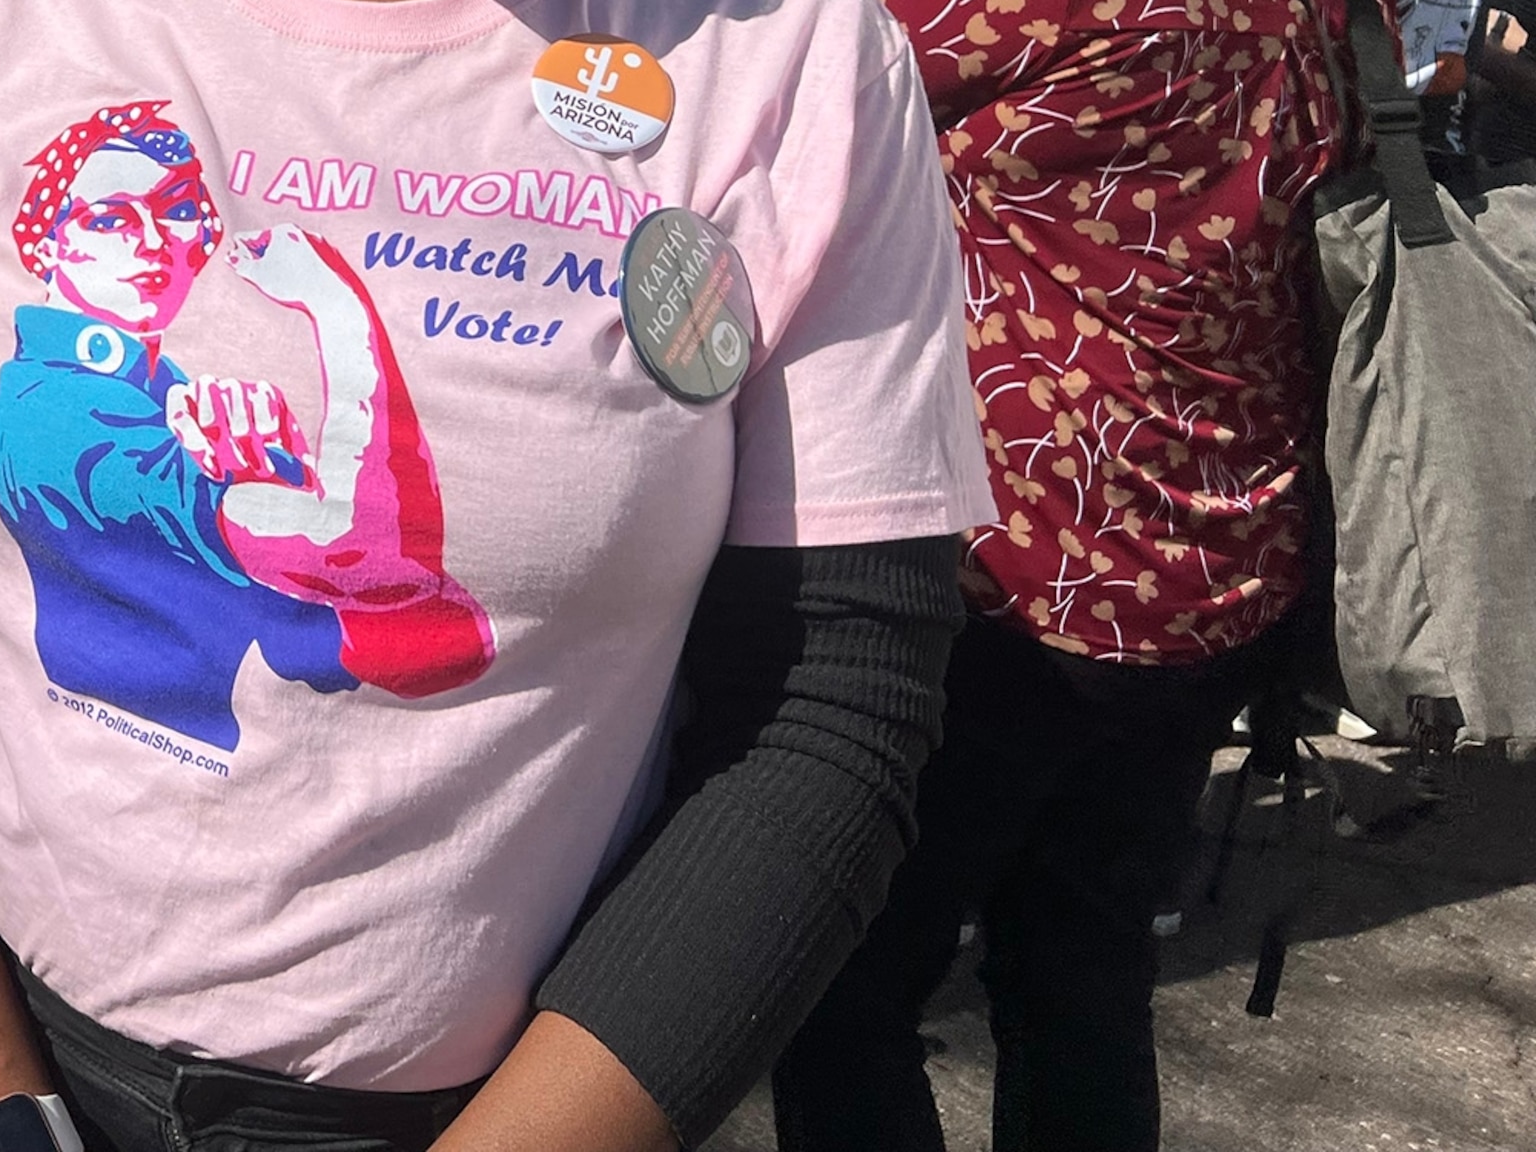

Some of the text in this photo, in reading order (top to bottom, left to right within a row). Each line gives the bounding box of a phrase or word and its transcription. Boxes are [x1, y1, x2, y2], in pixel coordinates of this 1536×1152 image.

[550, 105, 635, 143] ARIZONA
[554, 91, 639, 130] MISIÓN por
[229, 150, 661, 239] I AM WOMAN
[364, 231, 527, 282] Watch
[638, 221, 688, 302] KATHY
[646, 229, 716, 345] HOFFMAN
[423, 297, 563, 347] Vote!
[62, 696, 94, 720] 2012
[96, 708, 230, 777] PoliticalShop.com
